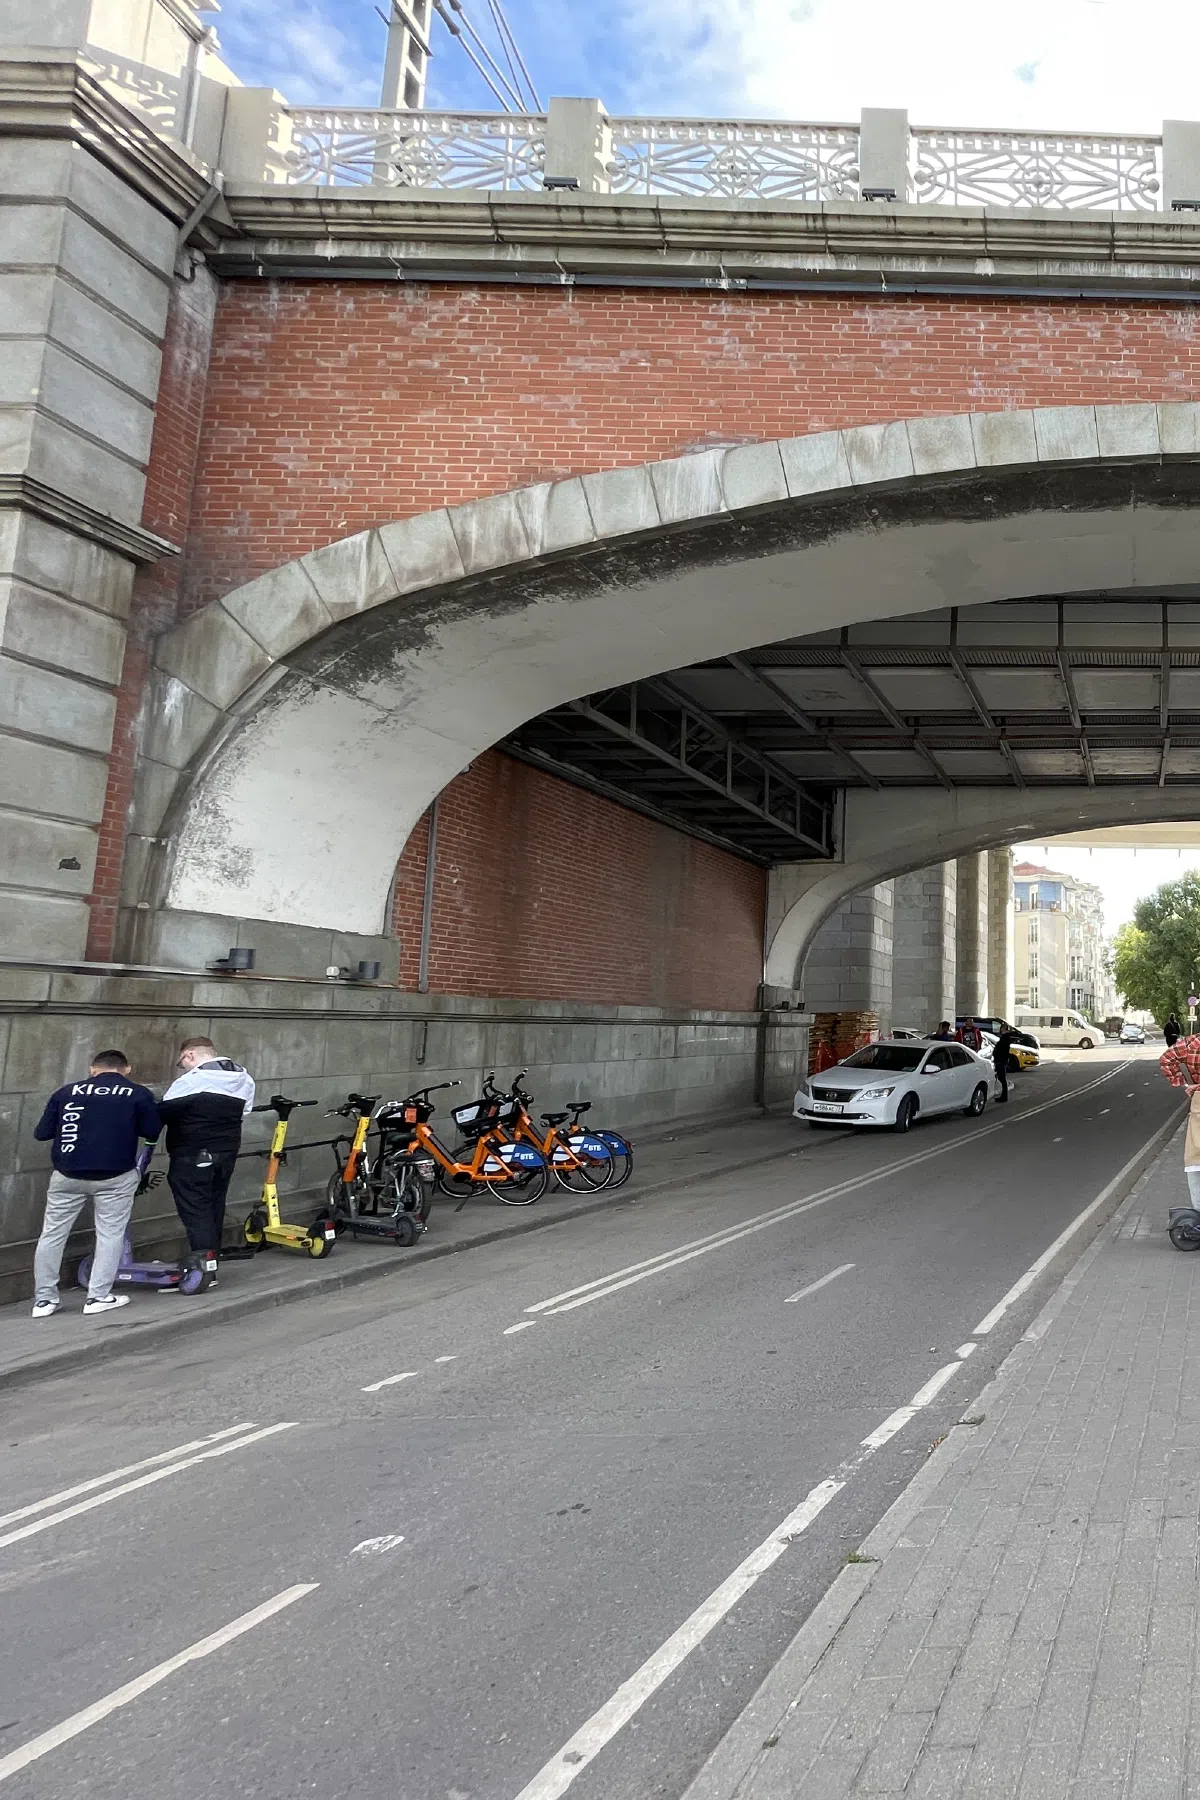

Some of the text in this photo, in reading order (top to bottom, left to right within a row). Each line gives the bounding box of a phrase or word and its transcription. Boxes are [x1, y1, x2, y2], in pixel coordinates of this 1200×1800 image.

[72, 1084, 133, 1096] Klein
[61, 1102, 85, 1153] Jeans
[588, 1143, 602, 1151] ВТБ
[520, 1152, 534, 1160] ВТБ
